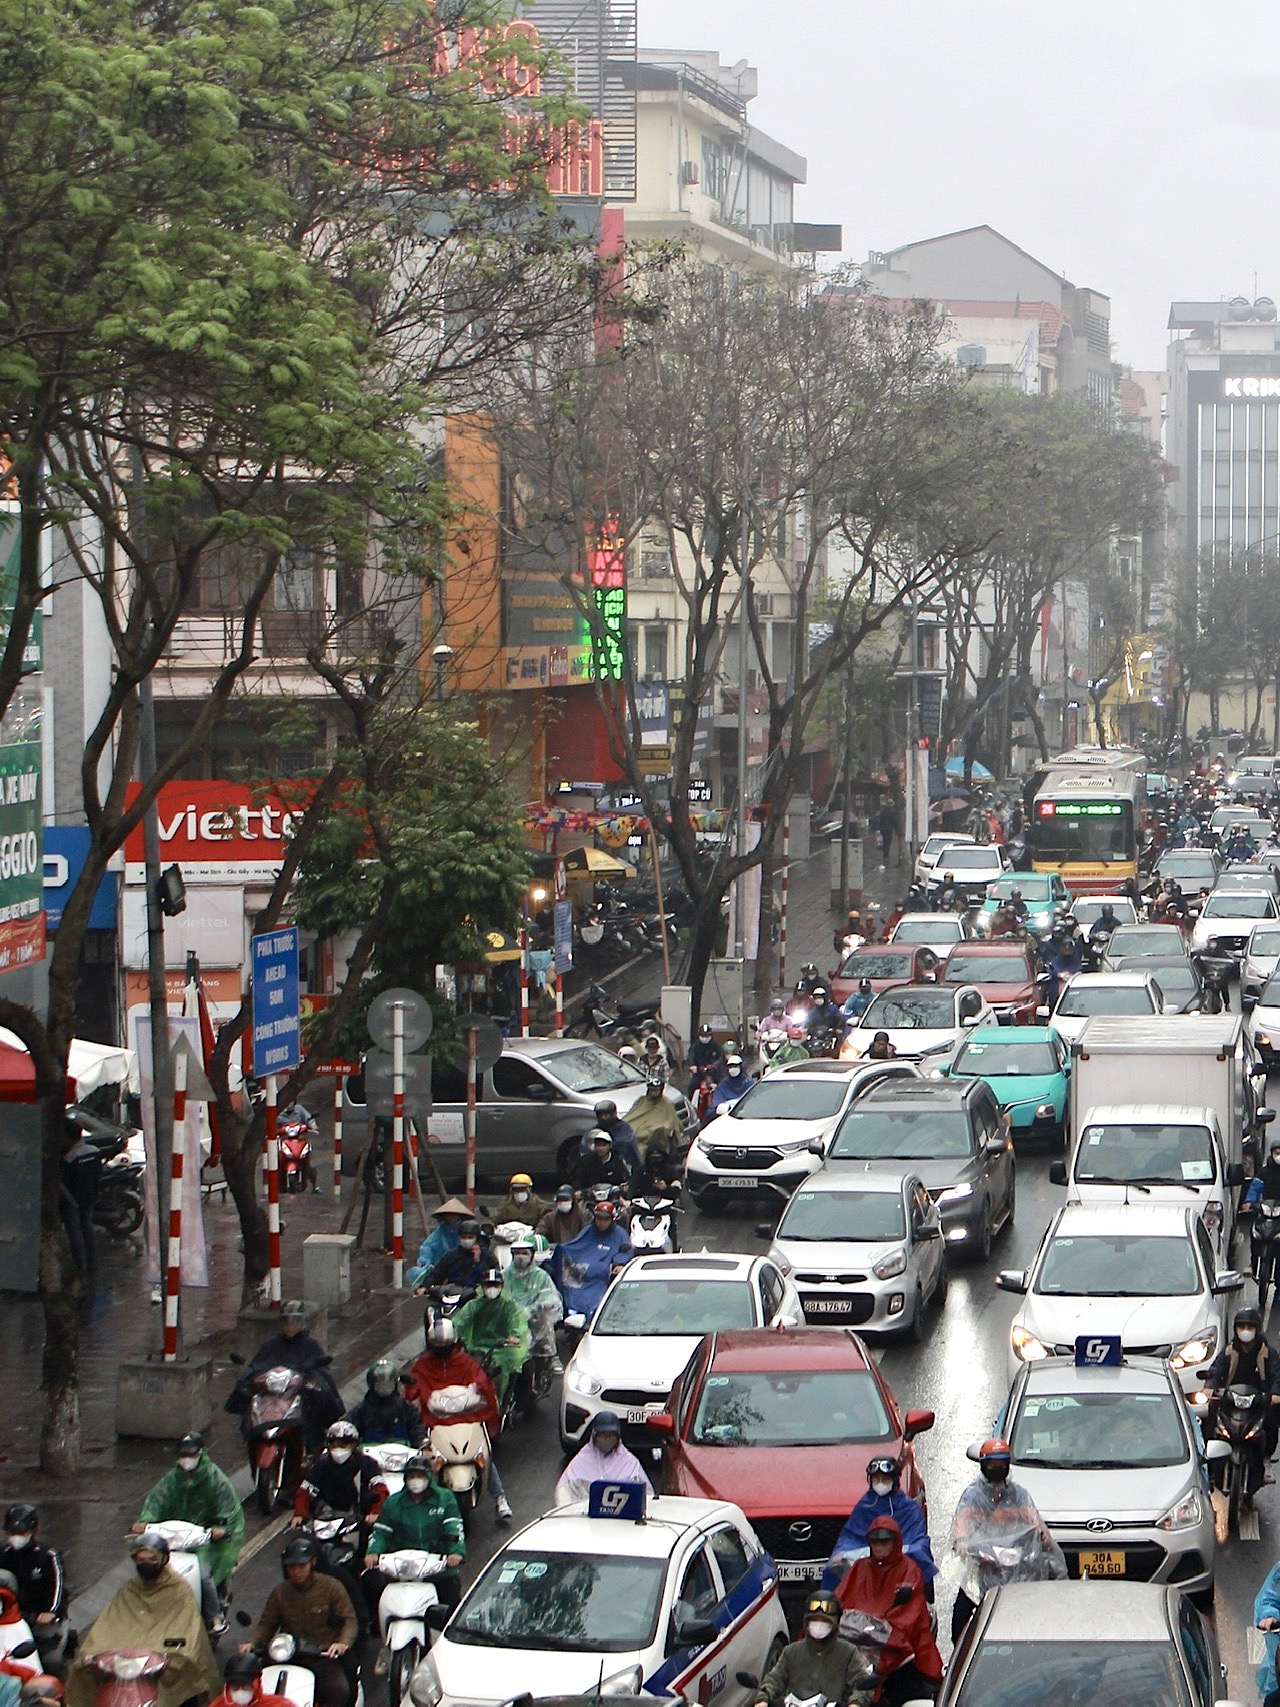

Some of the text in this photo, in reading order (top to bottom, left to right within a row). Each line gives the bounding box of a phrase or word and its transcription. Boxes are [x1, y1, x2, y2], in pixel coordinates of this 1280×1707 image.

[1042, 803, 1053, 814] 26
[0, 831, 38, 880] GGIO
[257, 931, 295, 958] PHÍA TRƯỚC
[265, 964, 286, 983] AHEAD
[269, 989, 284, 1006] 50M
[255, 1015, 298, 1042] CÔNG TRƯỜNG
[265, 1045, 289, 1066] WORKS
[1086, 1339, 1110, 1363] G7
[601, 1485, 629, 1515] G7
[1083, 1563, 1121, 1573] 949.60
[1092, 1552, 1112, 1563] 30A
